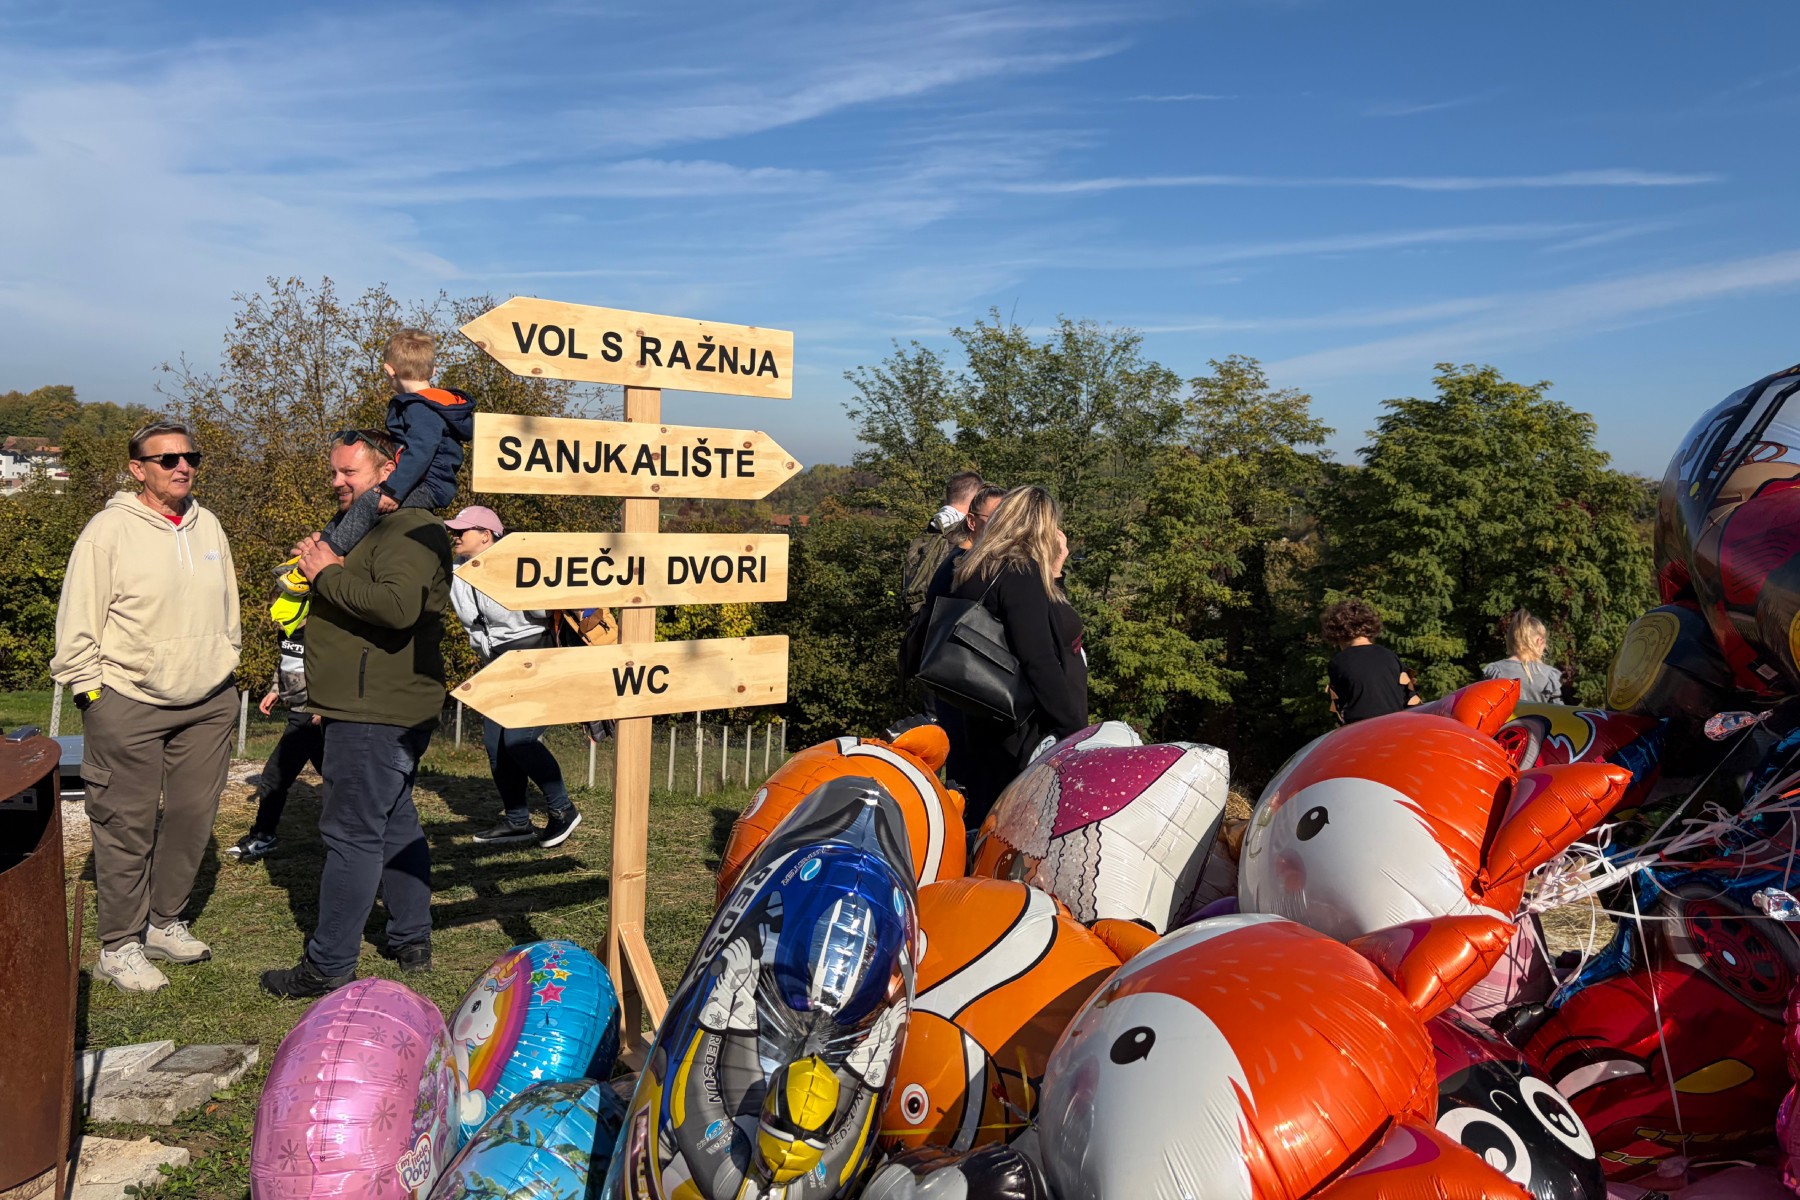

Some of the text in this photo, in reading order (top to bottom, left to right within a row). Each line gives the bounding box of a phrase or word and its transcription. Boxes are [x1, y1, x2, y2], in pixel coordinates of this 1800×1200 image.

[511, 321, 779, 379] VOL S RAŽNJA
[497, 435, 755, 478] SANJKALIŠTE
[515, 547, 767, 588] DJEČJI DVORI
[612, 664, 670, 697] WC
[703, 1033, 723, 1104] REDSUN
[402, 1149, 431, 1191] Pony
